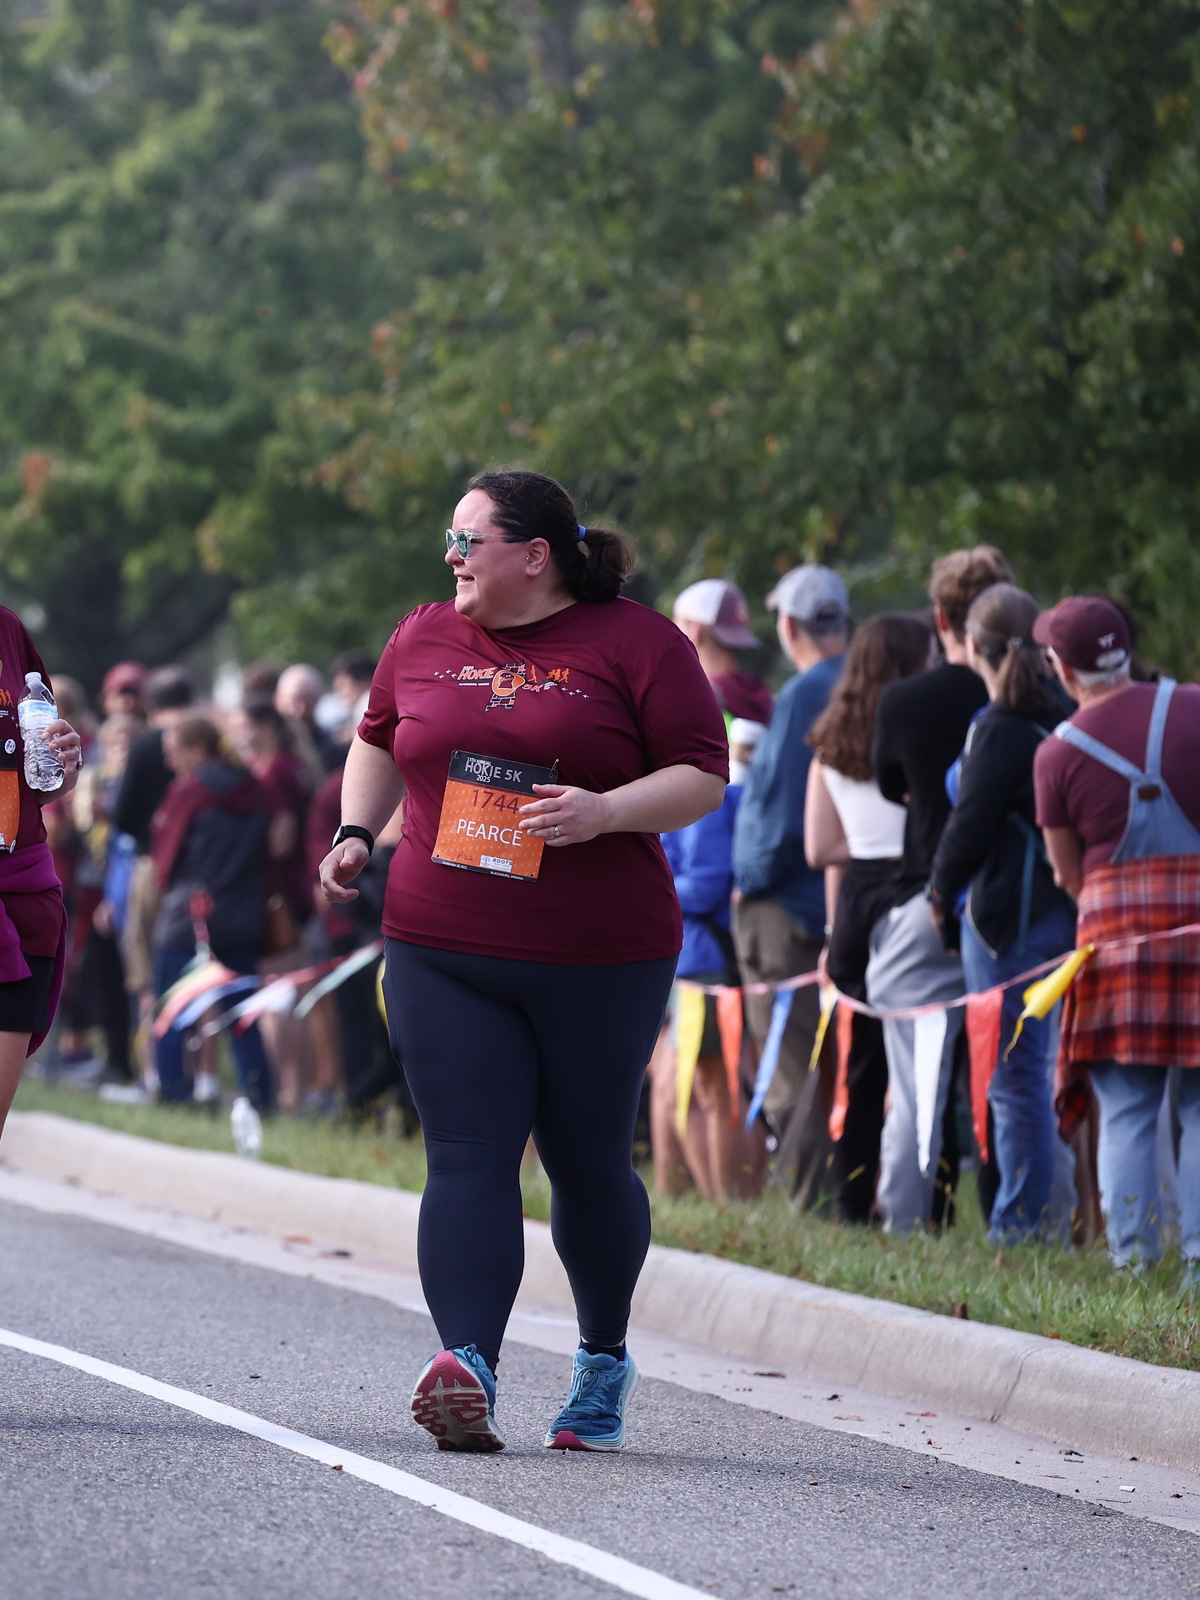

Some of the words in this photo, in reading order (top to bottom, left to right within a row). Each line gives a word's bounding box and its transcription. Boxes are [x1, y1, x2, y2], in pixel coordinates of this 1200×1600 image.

[457, 667, 498, 680] HOKIE
[464, 760, 502, 779] HOKIE
[504, 769, 522, 783] 5K
[476, 774, 491, 784] 2025
[473, 789, 520, 815] 1744
[456, 818, 523, 847] PEARCE
[492, 858, 513, 866] ROOTS
